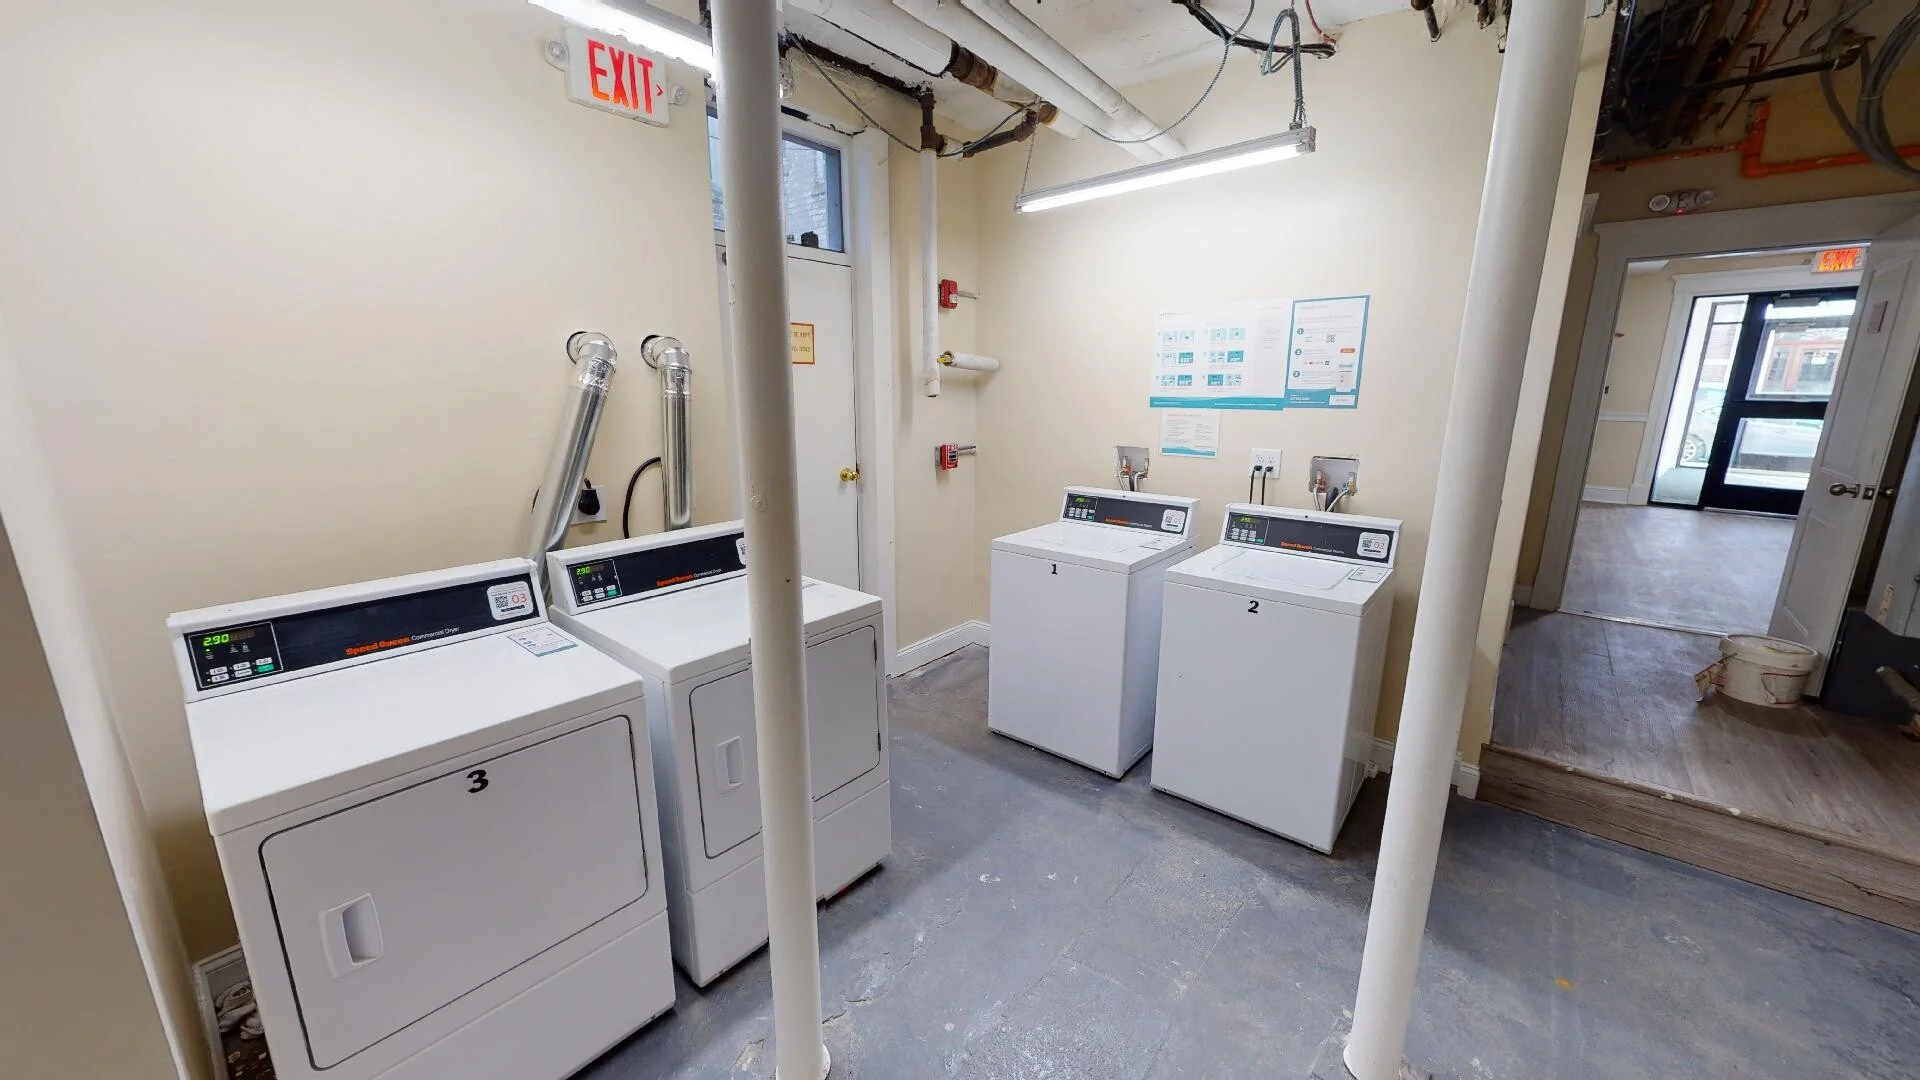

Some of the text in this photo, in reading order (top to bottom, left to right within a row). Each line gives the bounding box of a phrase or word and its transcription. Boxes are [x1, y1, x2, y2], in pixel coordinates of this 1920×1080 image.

[587, 38, 653, 113] EXIT
[1820, 249, 1857, 271] EXIT
[1051, 563, 1058, 575] 1
[511, 593, 527, 604] 03
[1248, 600, 1259, 614] 2
[203, 633, 229, 646] 2.90
[345, 627, 460, 656] Speed Queen Commercial Dryer
[466, 769, 489, 793] 3
